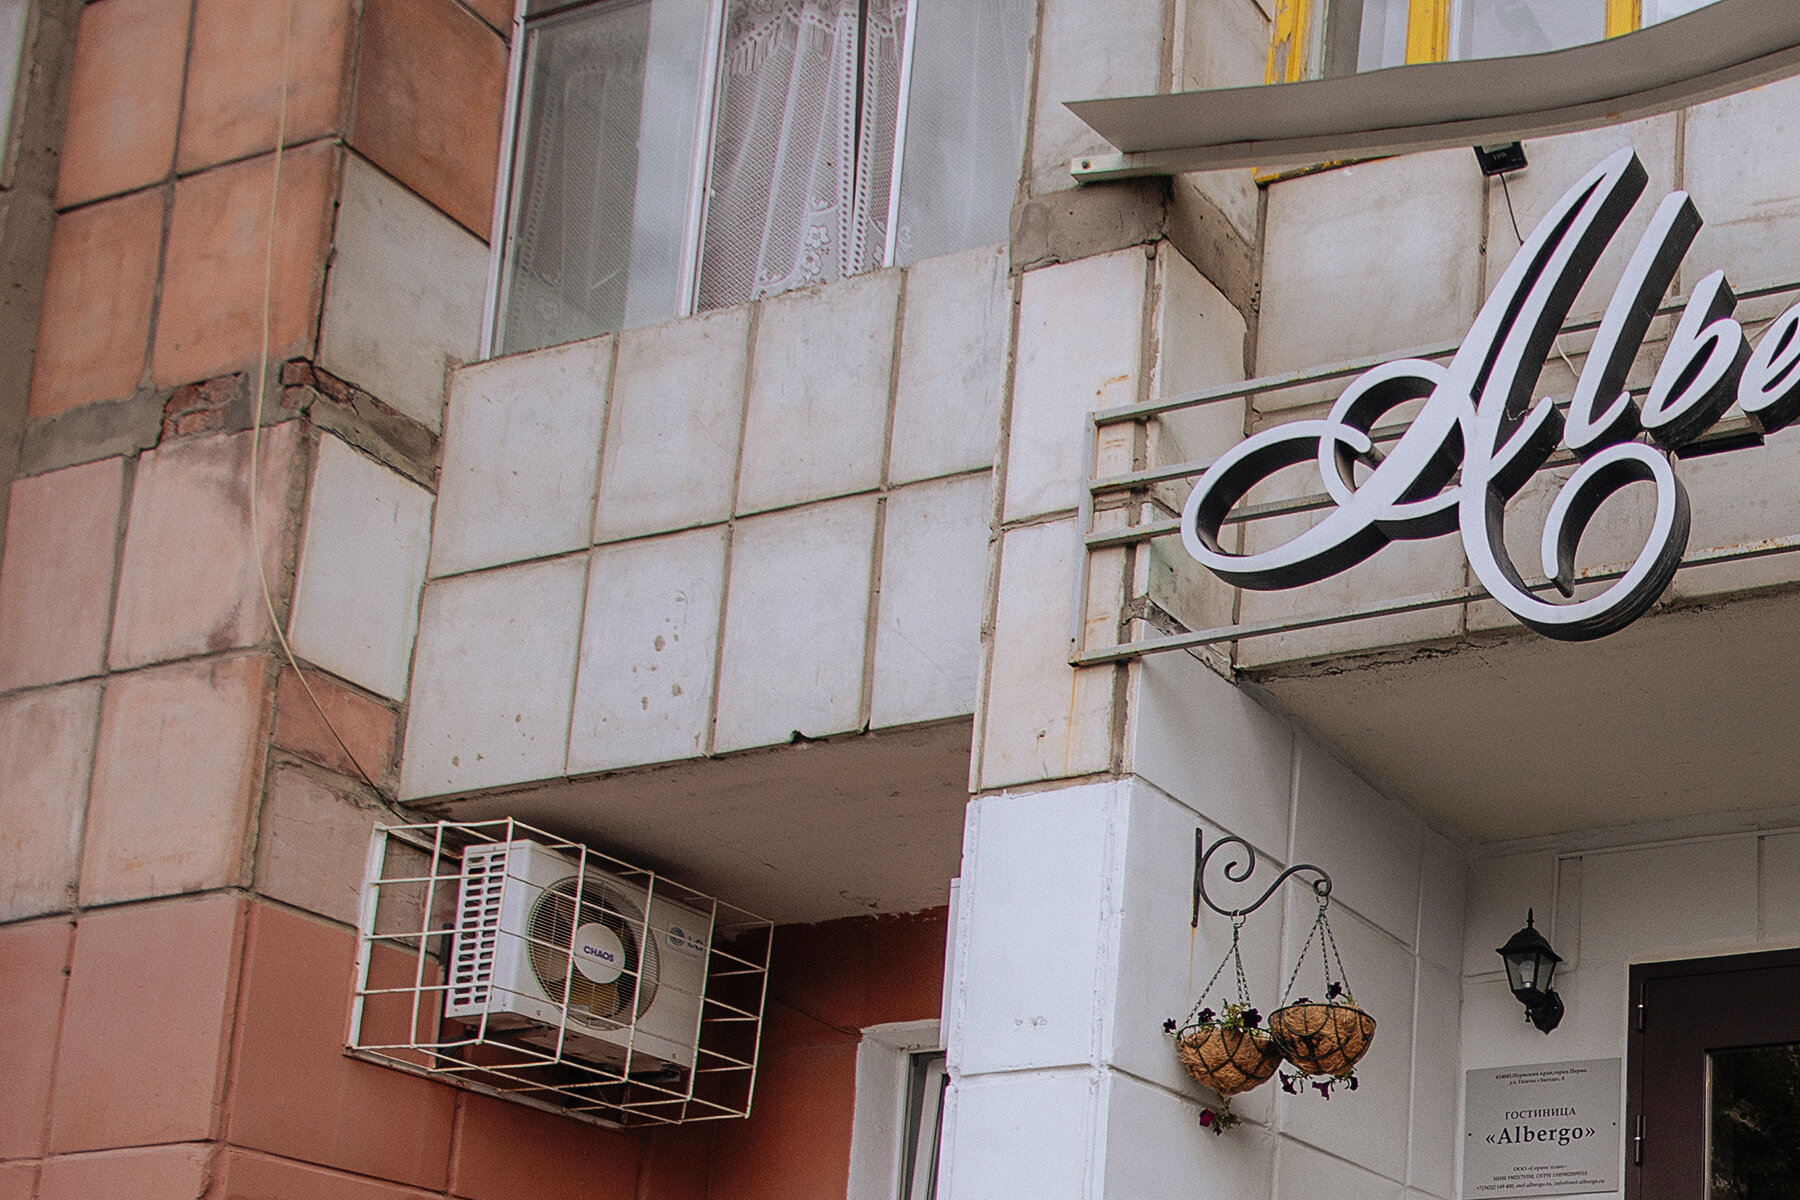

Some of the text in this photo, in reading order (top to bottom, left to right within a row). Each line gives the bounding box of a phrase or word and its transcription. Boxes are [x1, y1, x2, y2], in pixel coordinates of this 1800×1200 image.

[583, 945, 615, 963] CHAOS
[1505, 1107, 1577, 1120] ГОСТИНИЦА
[1485, 1126, 1596, 1146] «Albergo»
